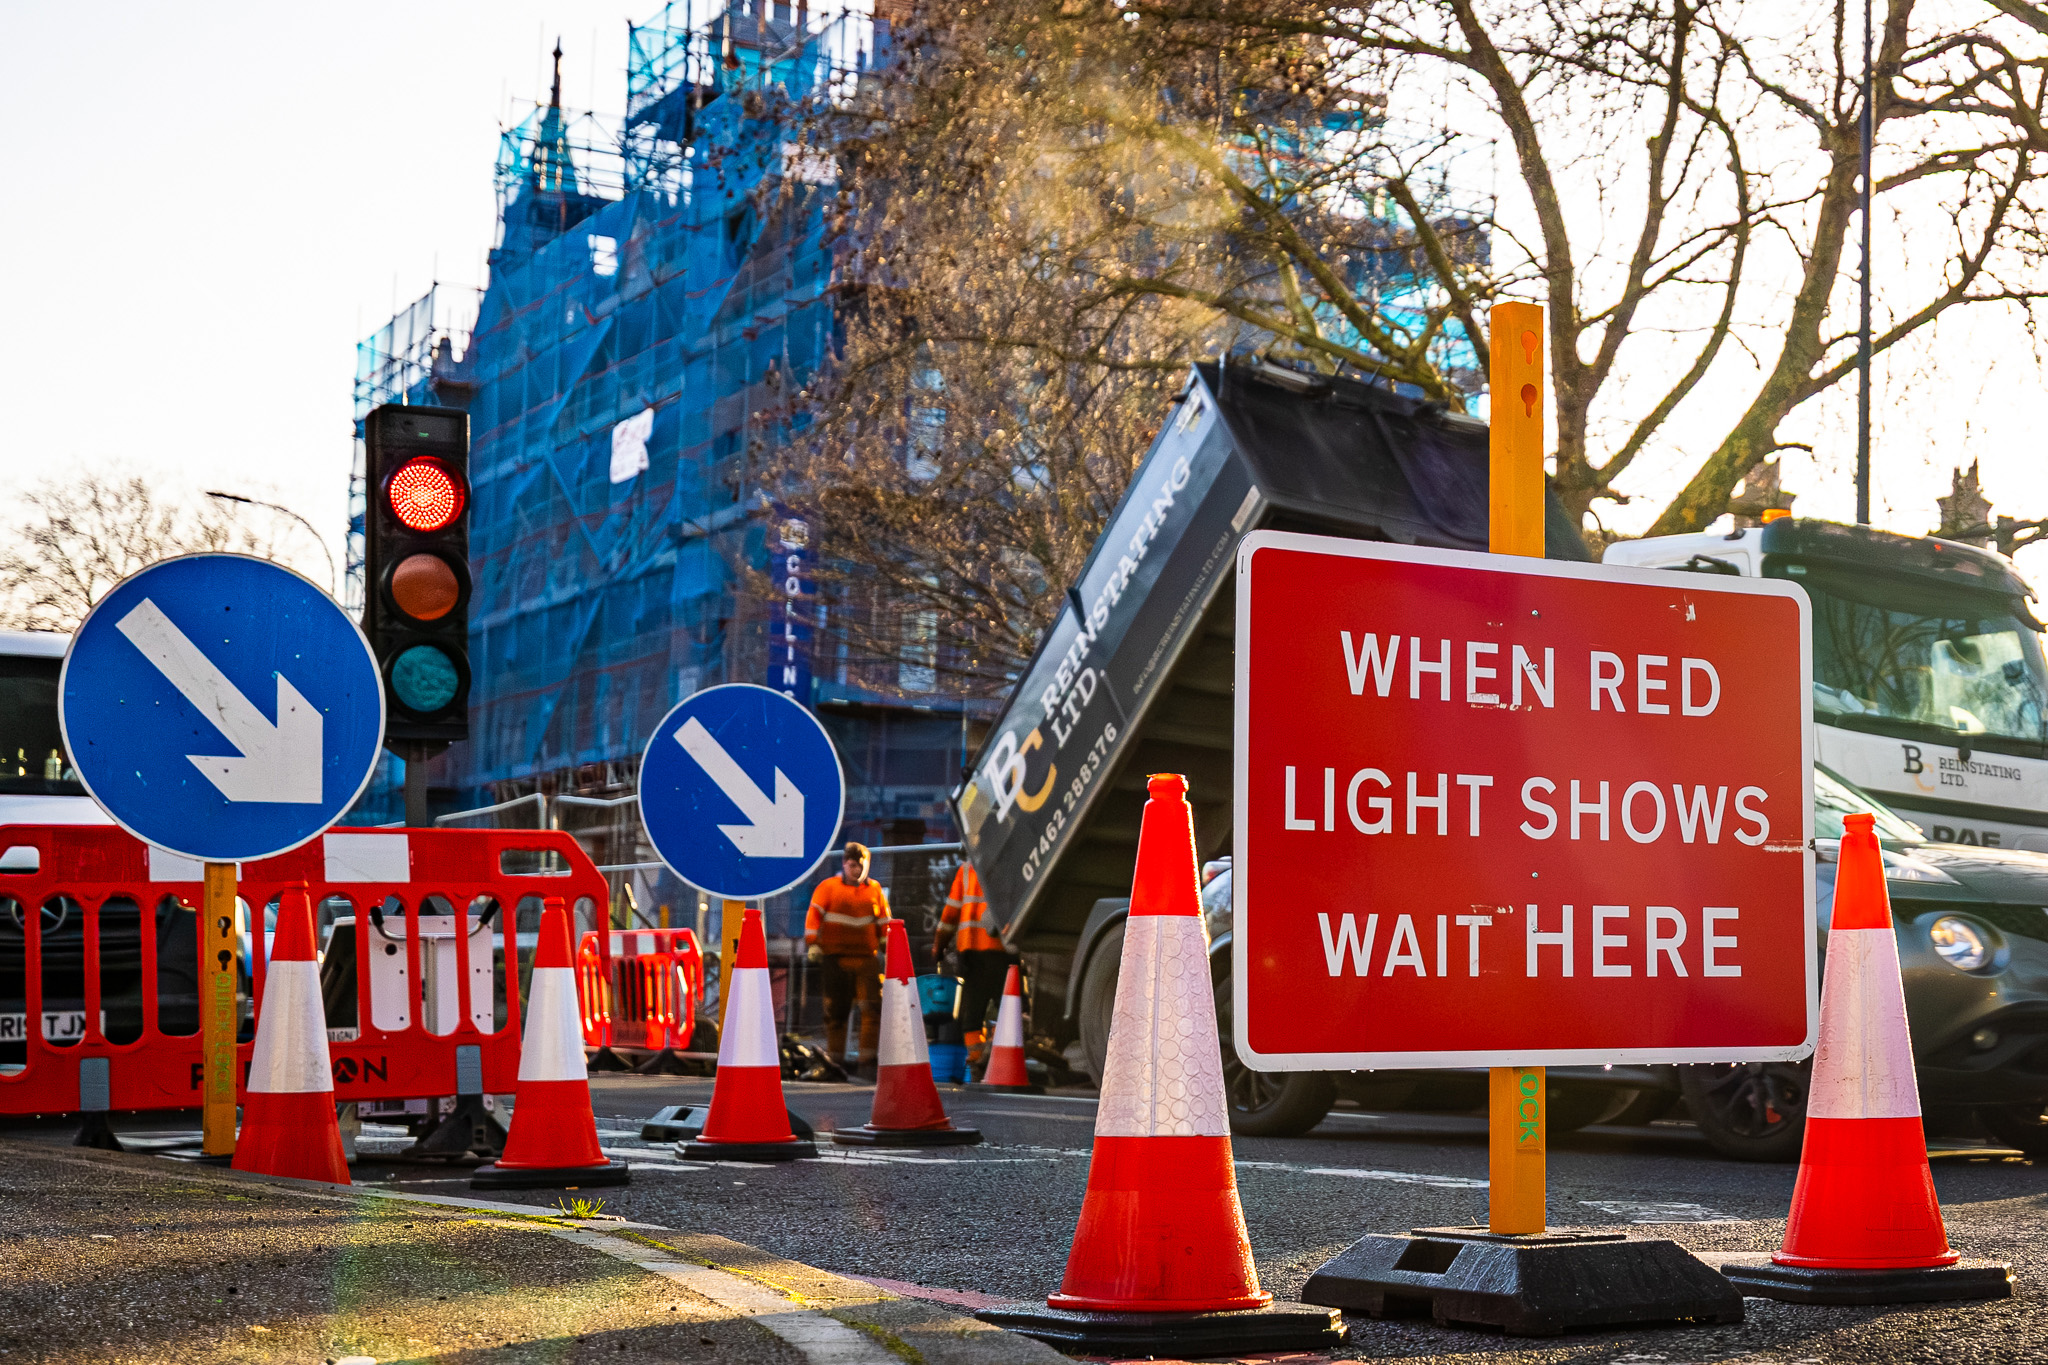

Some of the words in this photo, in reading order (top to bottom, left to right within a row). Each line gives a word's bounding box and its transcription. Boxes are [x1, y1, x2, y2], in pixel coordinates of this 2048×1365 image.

[1040, 455, 1191, 721] REINSTATING
[1050, 667, 1106, 748] LTD.
[1340, 630, 1555, 709] WHEN
[1590, 651, 1721, 717] RED
[1022, 809, 1067, 882] 07462
[1064, 722, 1117, 812] 288376
[1284, 766, 1494, 837] LIGHT
[1519, 776, 1771, 846] SHOWS
[1938, 757, 2022, 781] REINSTATING
[1317, 912, 1493, 978] WAIT
[1526, 904, 1742, 978] HERE
[1519, 1067, 1540, 1143] OCK
